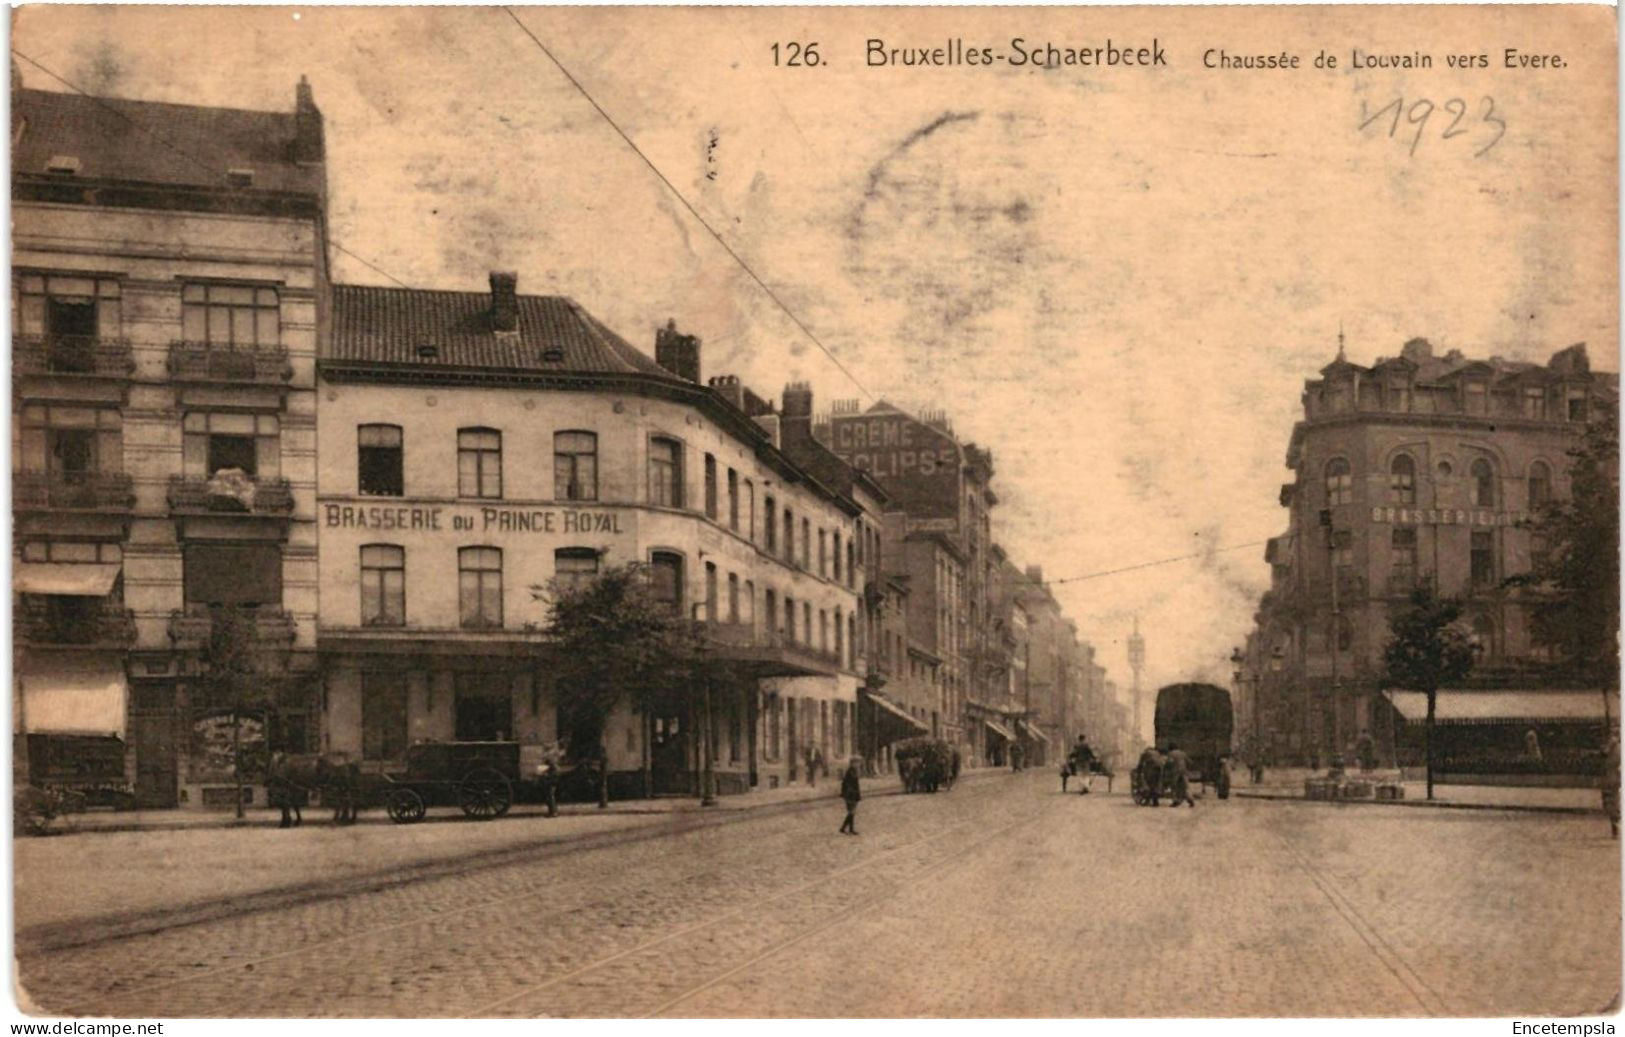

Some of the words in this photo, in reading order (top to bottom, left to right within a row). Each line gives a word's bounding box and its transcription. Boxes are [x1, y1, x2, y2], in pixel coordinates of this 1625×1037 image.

[325, 504, 443, 530] BRASSERIE
[482, 506, 555, 533] PRINCE
[564, 510, 624, 535] ROYAL
[1371, 506, 1490, 526] BRASSERIE
